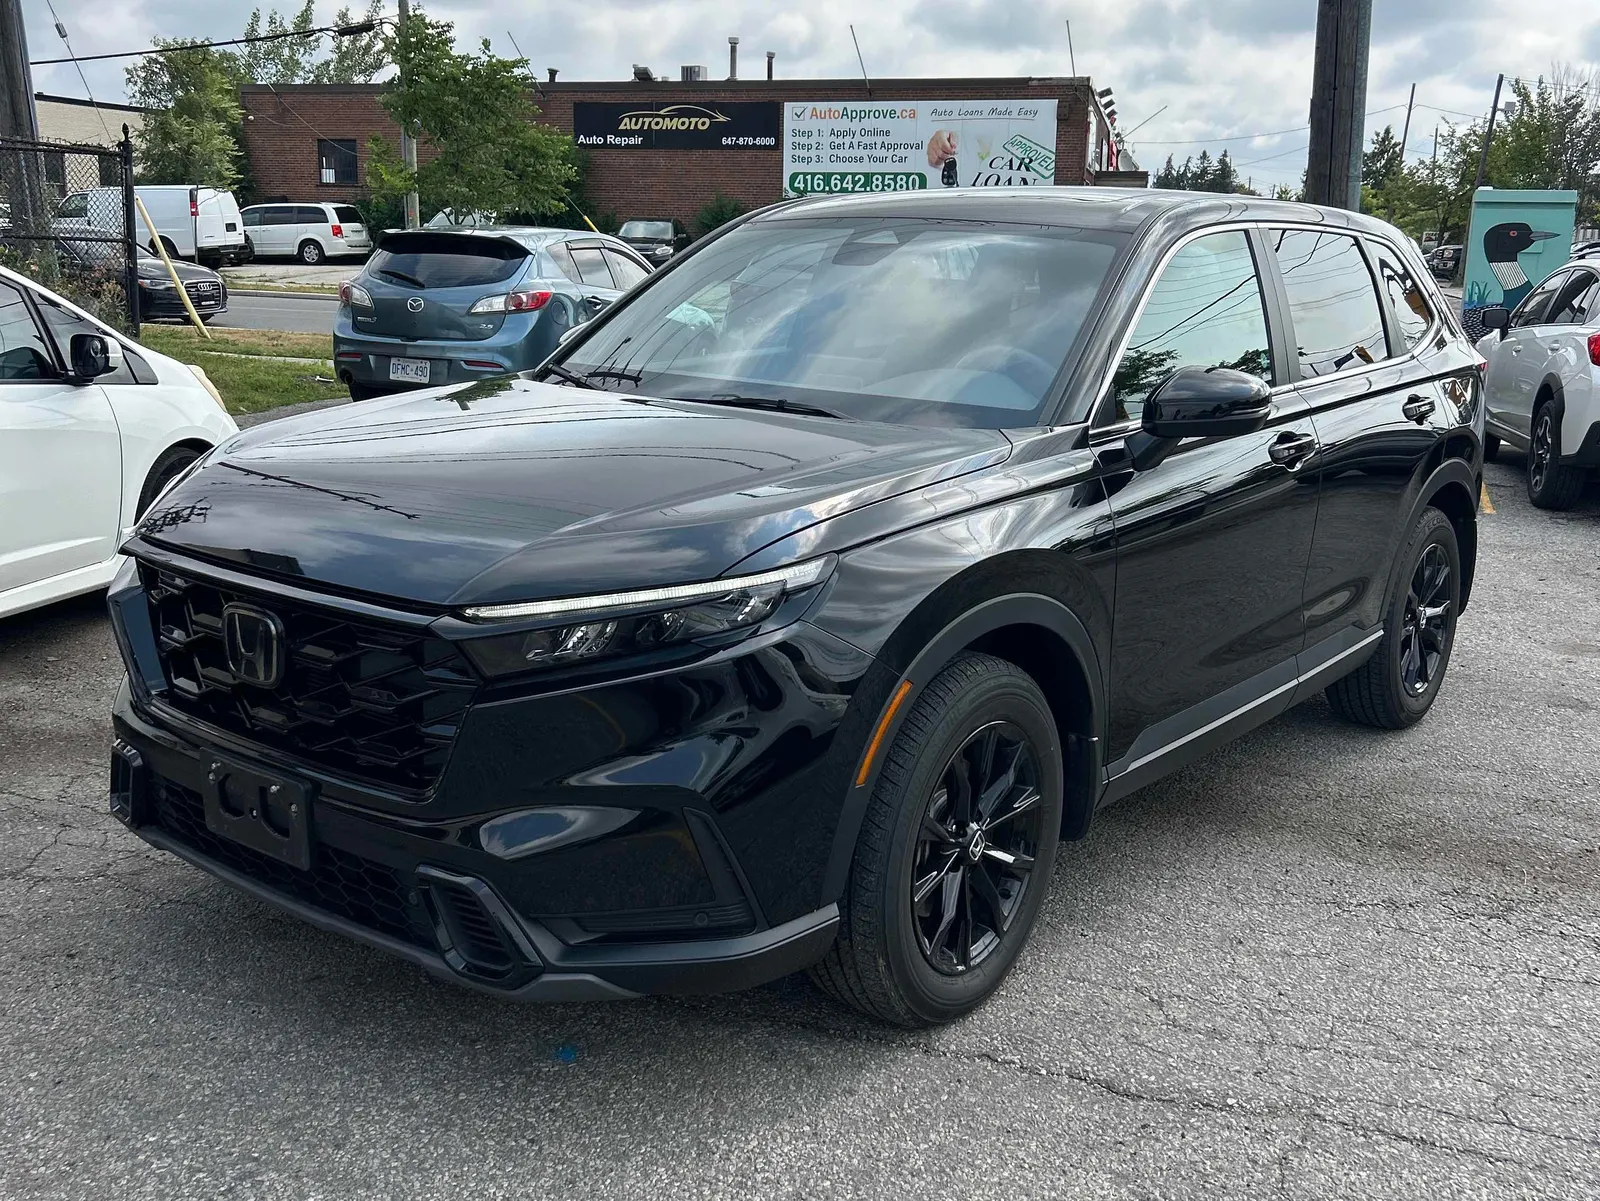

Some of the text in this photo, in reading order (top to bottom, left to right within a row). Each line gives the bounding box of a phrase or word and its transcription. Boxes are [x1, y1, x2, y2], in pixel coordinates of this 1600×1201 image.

[810, 106, 916, 122] AutoApprove.ca
[931, 107, 1038, 118] Auto Loans Made Easy
[618, 117, 711, 130] AUTOMOTO
[791, 127, 891, 139] Step 1: Apply Online
[577, 134, 643, 146] Auto Repair
[721, 136, 775, 145] 647-870-6000
[791, 140, 924, 152] Step 2: Get A Fast Approval
[791, 154, 908, 165] Step 3: Choose Your Car
[1008, 139, 1055, 171] APPROVED
[989, 156, 1034, 172] CAR
[794, 174, 920, 192] 416.642.8580
